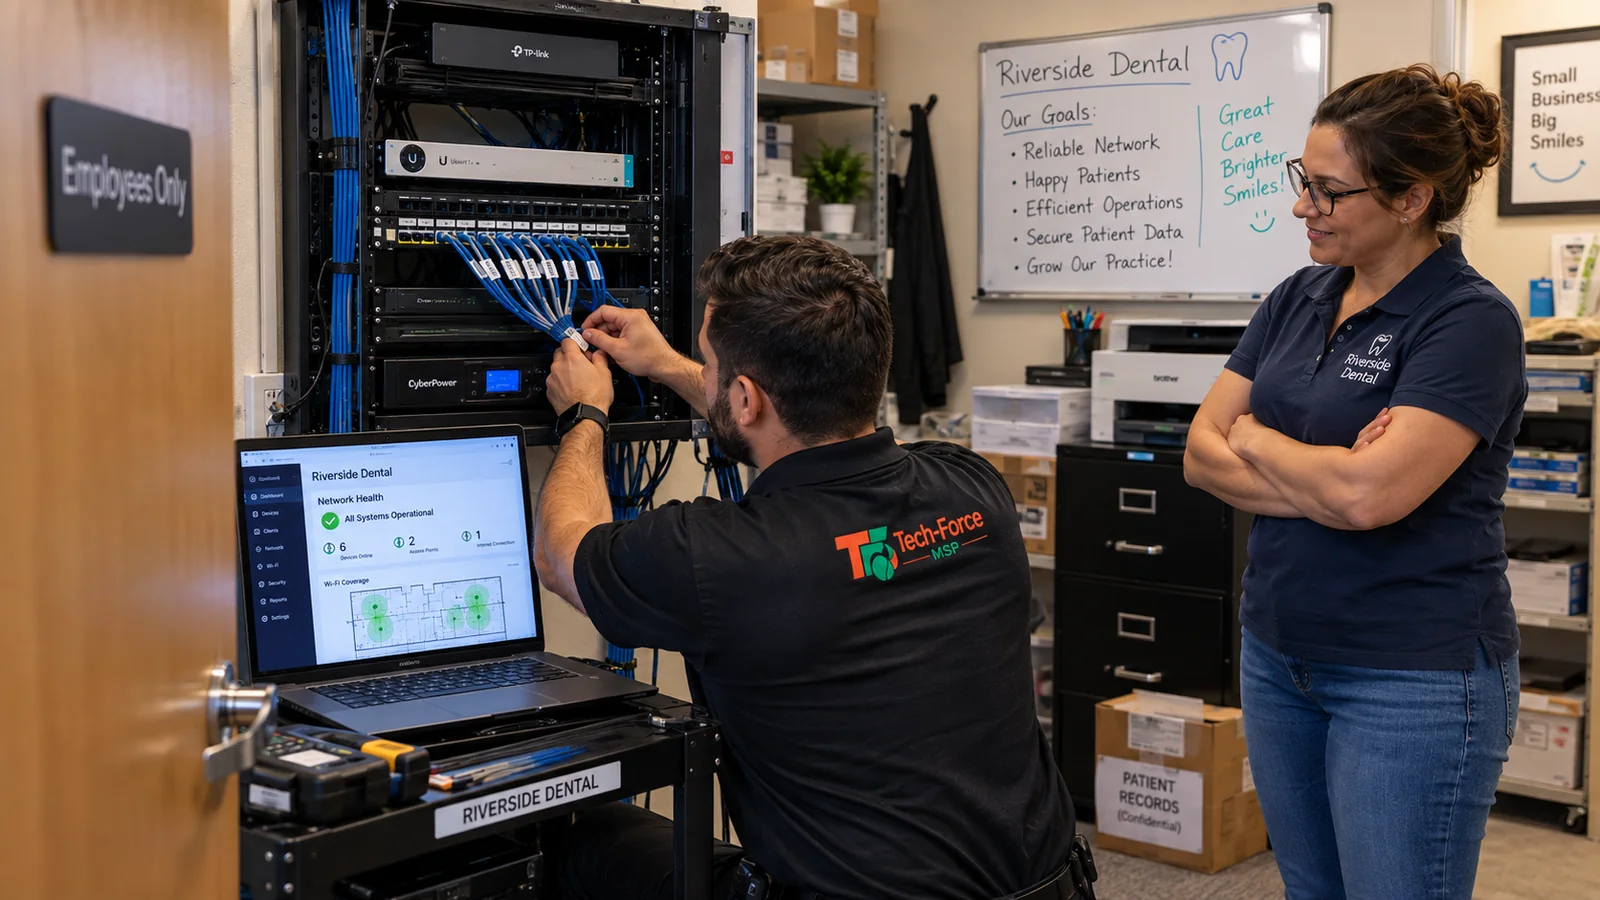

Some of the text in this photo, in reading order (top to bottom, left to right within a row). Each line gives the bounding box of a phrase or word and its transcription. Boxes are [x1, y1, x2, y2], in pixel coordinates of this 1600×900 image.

[996, 45, 1190, 87] Riverside Dental
[1532, 67, 1577, 86] Small
[1001, 102, 1097, 130] Our Goals:
[1219, 95, 1275, 126] Great
[1531, 113, 1557, 131] Big
[1023, 133, 1160, 161] Reliable Network
[1220, 130, 1263, 152] Care
[1530, 133, 1584, 150] Smiles
[1220, 150, 1288, 180] Brighter
[61, 145, 187, 217] Employees Only
[1025, 165, 1141, 193] Happy Patients
[1223, 173, 1286, 206] Smiles!
[1026, 194, 1184, 220] Efficient Operations
[1026, 221, 1184, 247] Secure Patient Data
[1027, 249, 1173, 275] Grow Our Practice!
[1344, 353, 1391, 371] Riverside
[408, 379, 457, 390] CyberPower
[1340, 367, 1380, 385] Dental
[311, 467, 393, 481] Riverside Dental
[317, 493, 384, 506] Network Health
[344, 508, 434, 523] All Systems Operational
[408, 536, 416, 546] 2
[475, 530, 481, 540] 1
[893, 511, 984, 553] Tech-Force
[339, 542, 347, 552] 6
[931, 541, 960, 561] MSP
[341, 577, 370, 586] Coverage
[1122, 771, 1175, 793] PATIENT
[463, 774, 599, 825] RIVERSIDE DENTAL
[1119, 790, 1180, 814] RECORDS
[1117, 809, 1182, 835] (Confidential)
